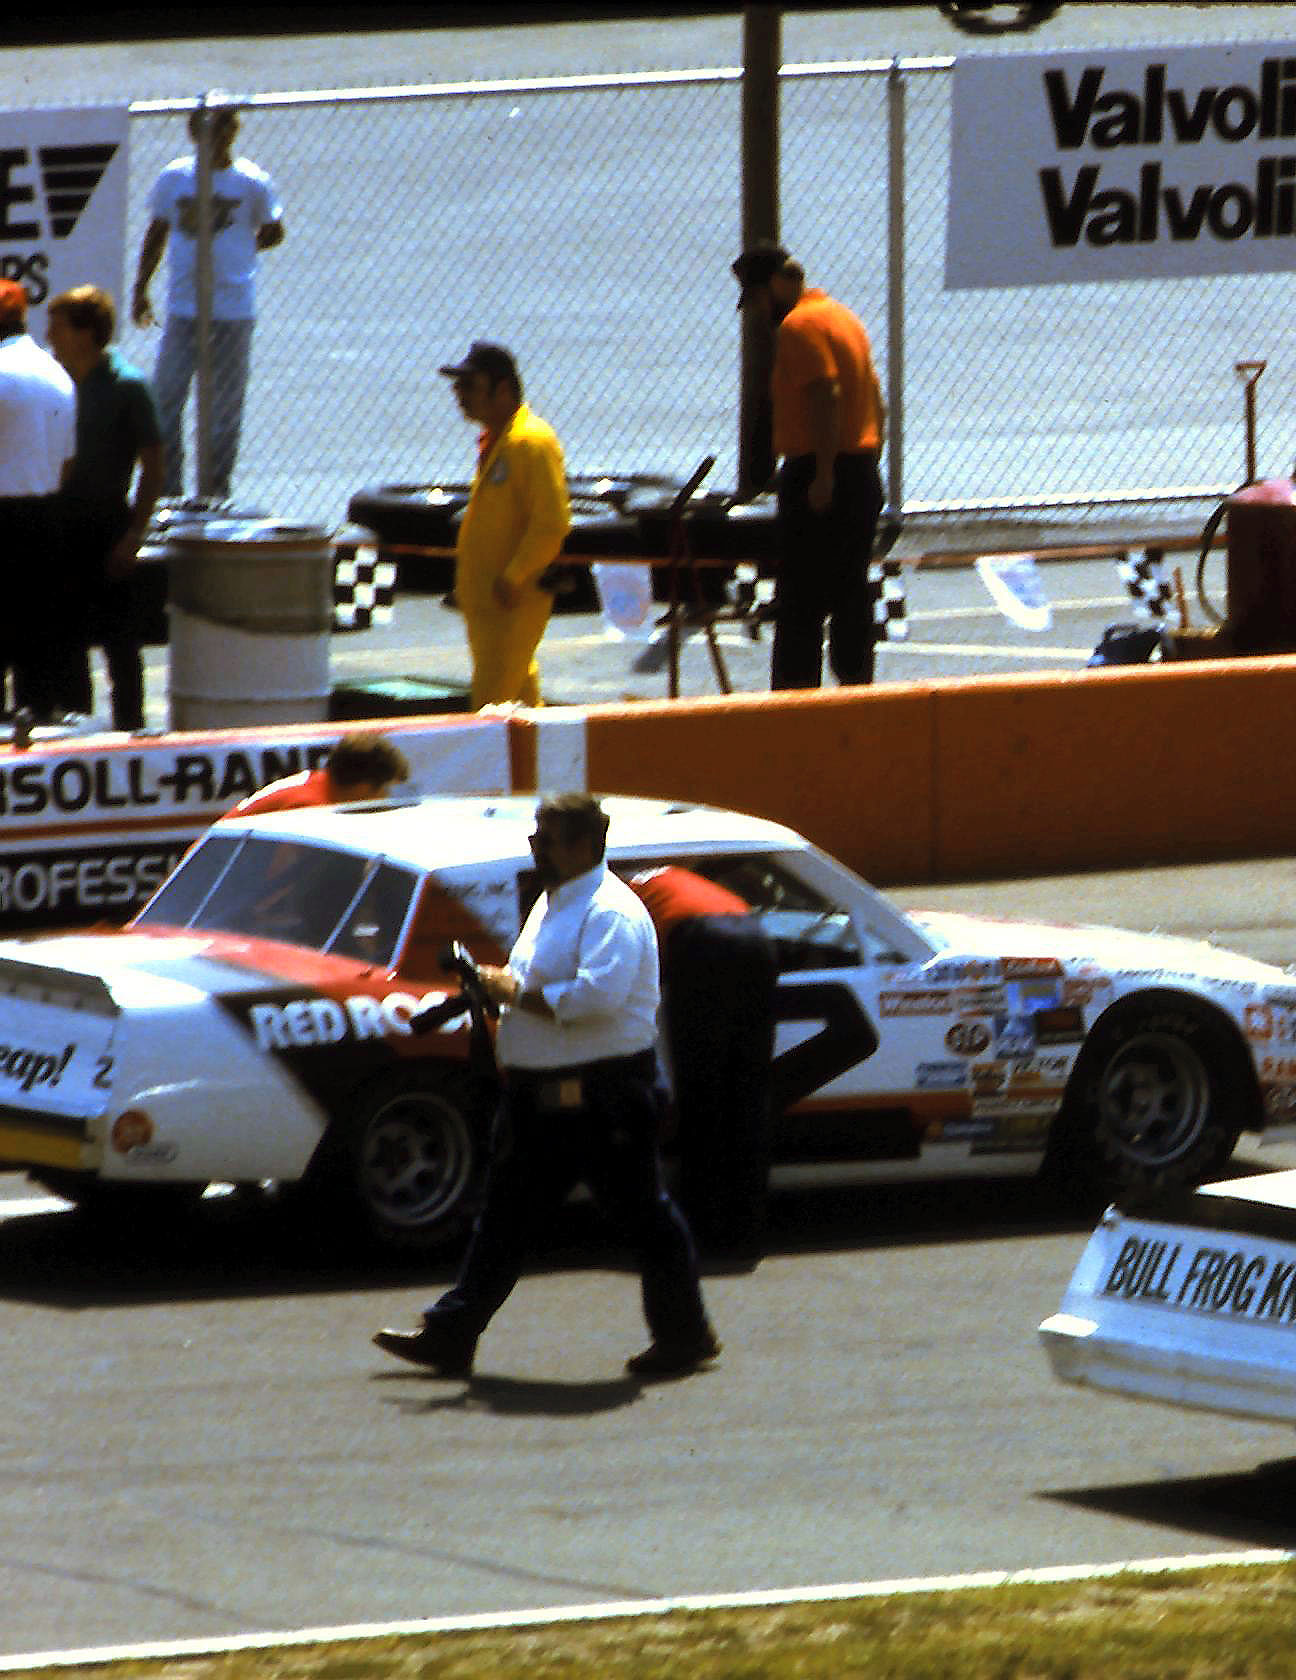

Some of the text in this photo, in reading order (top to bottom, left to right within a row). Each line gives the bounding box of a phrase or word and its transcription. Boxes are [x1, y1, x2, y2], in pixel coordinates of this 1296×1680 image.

[0, 746, 331, 816] SOLL-RAN
[0, 853, 177, 913] OFESS
[252, 997, 348, 1050] RED
[93, 1055, 114, 1090] 2
[1104, 1234, 1183, 1301] BULL
[1176, 1247, 1267, 1313] FROG
